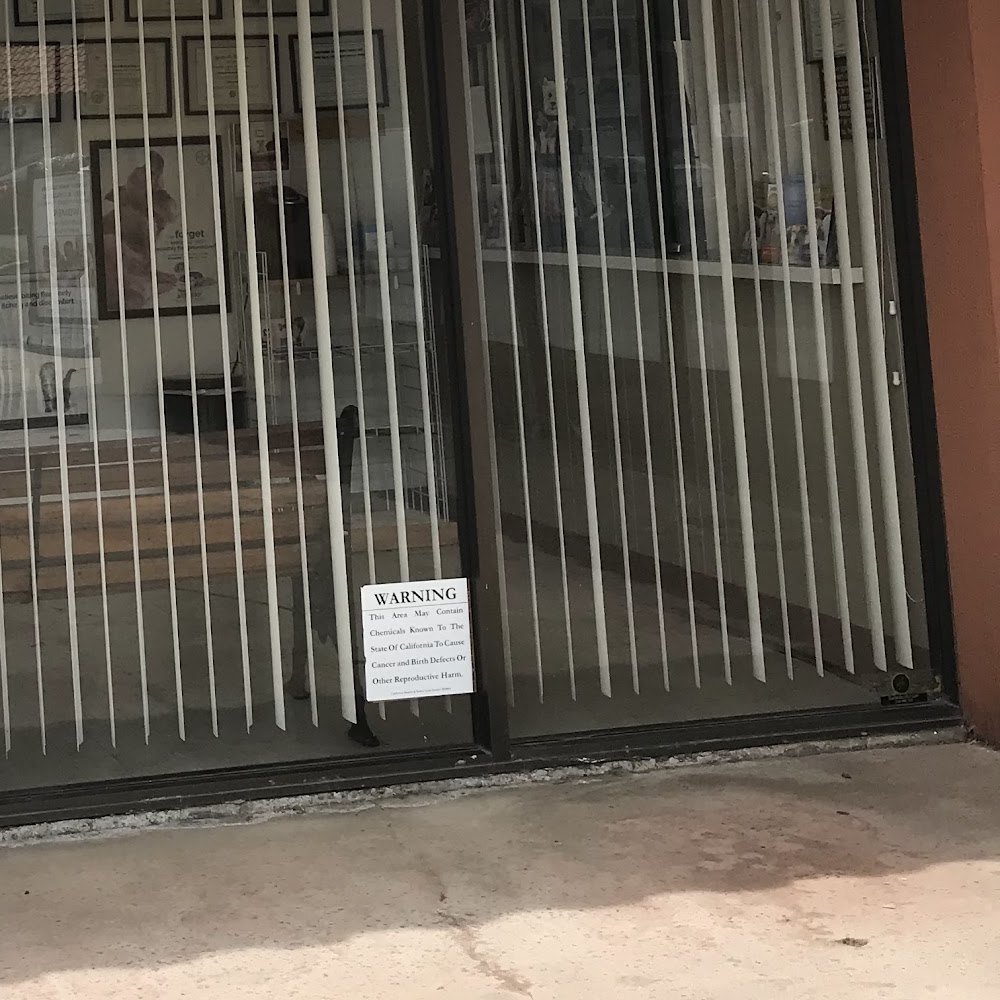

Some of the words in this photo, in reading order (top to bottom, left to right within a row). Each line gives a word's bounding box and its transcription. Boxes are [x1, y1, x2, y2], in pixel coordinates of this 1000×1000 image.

[374, 588, 457, 605] WARNING
[370, 627, 406, 636] Chemicals
[400, 642, 434, 651] California
[397, 659, 410, 667] and
[411, 657, 429, 665] Birth
[430, 656, 456, 664] Defects
[394, 673, 439, 684] Reproductive
[441, 671, 464, 679] Harm.
